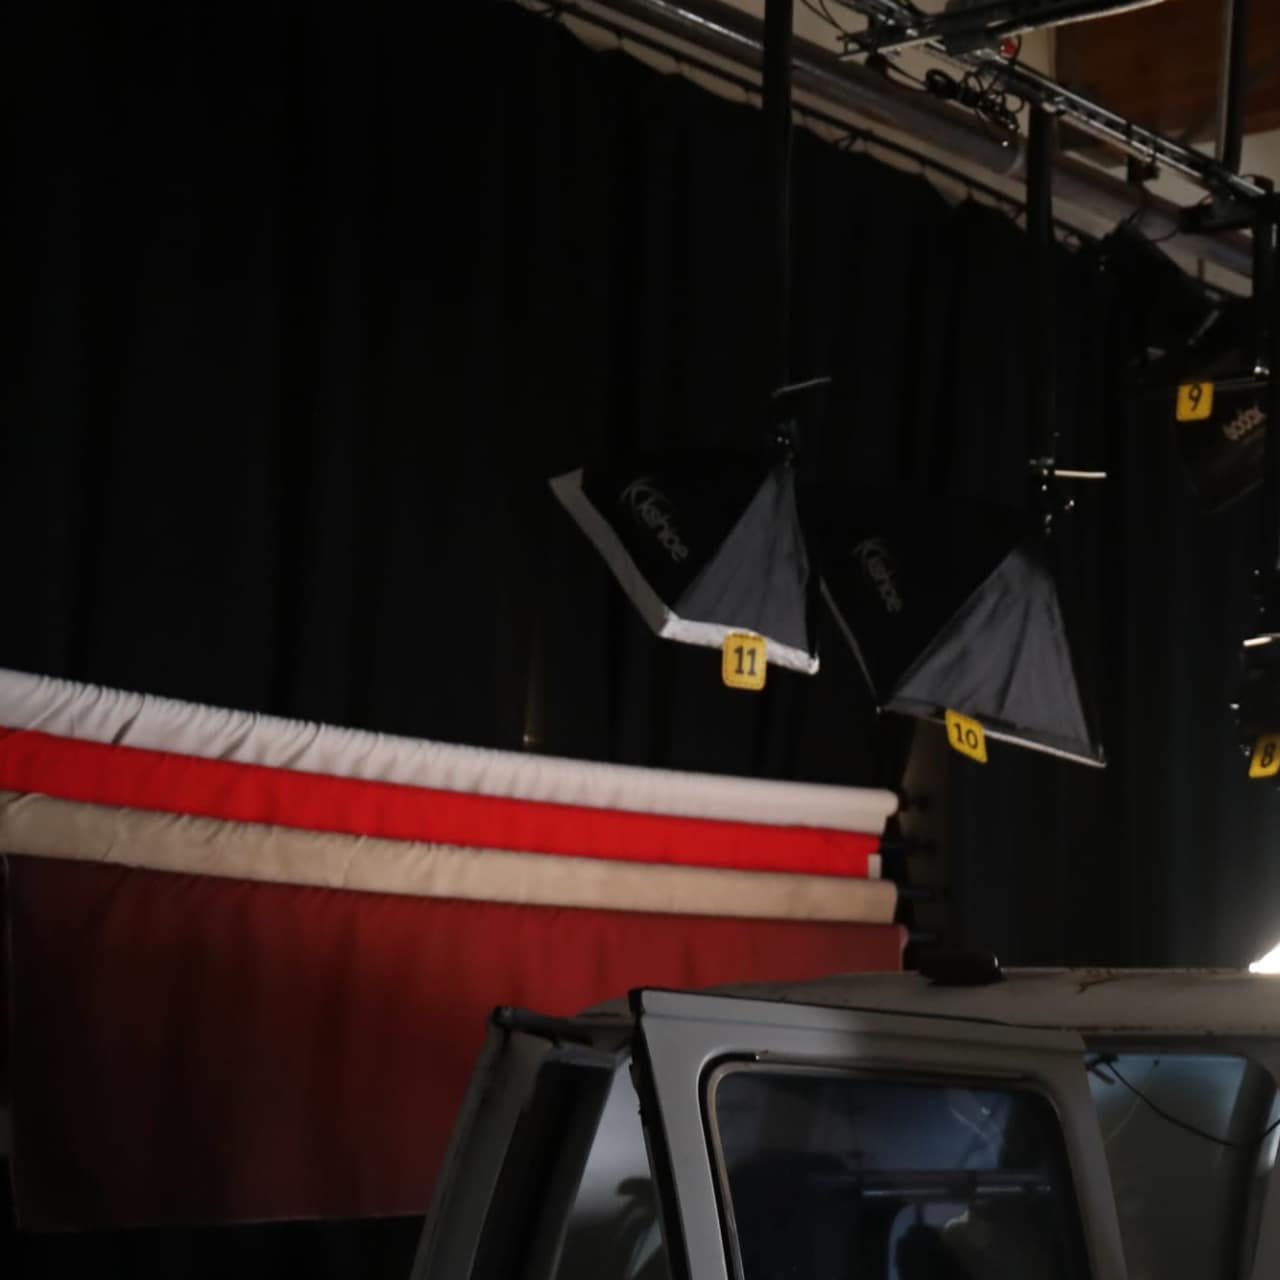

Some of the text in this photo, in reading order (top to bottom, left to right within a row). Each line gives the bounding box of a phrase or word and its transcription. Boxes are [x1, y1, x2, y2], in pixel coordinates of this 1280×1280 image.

[1188, 384, 1202, 412] 9
[734, 645, 757, 675] 11
[954, 723, 978, 749] 10
[1260, 742, 1276, 768] 8
